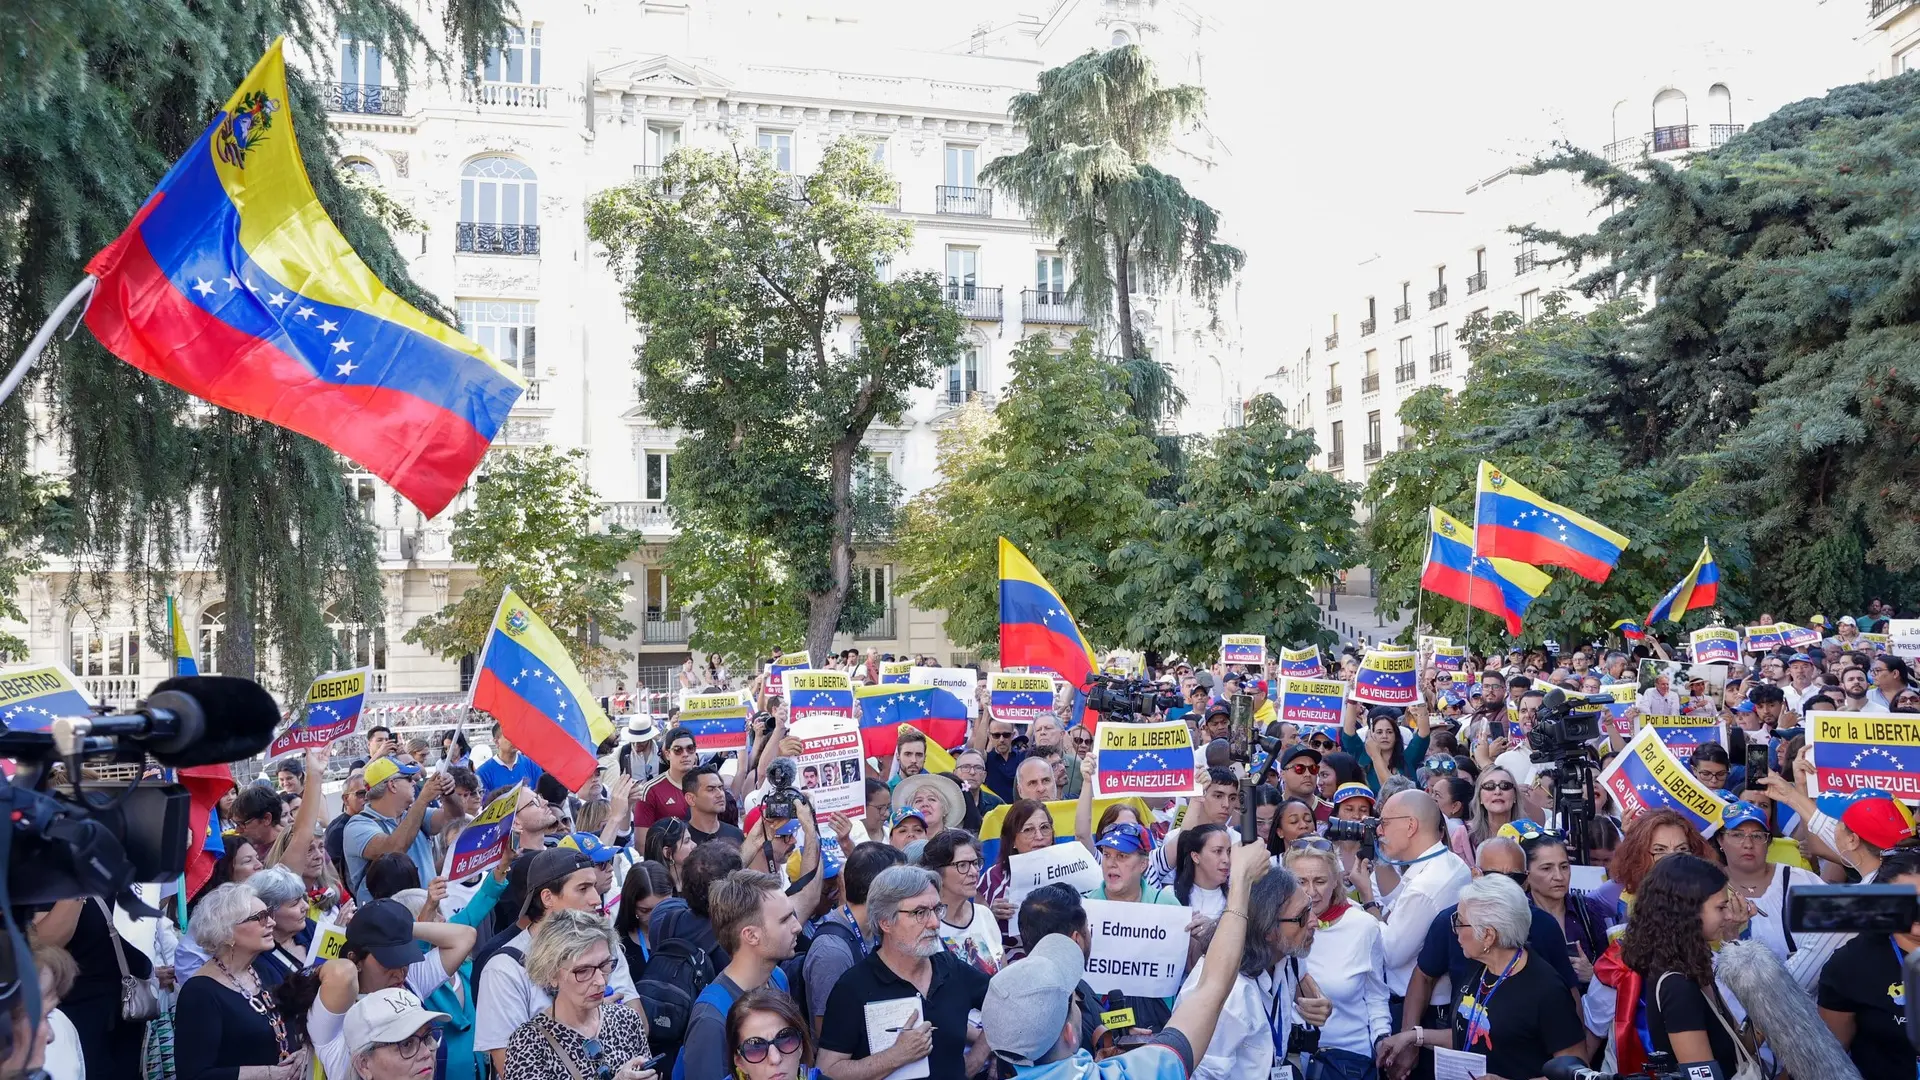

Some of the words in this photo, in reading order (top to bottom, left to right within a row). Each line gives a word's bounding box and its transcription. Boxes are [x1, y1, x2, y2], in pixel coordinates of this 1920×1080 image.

[1374, 659, 1379, 669] la
[1383, 659, 1412, 671] LIBERTAD
[311, 678, 359, 699] LIBERTAD
[794, 676, 806, 687] Por
[809, 677, 815, 687] la
[818, 677, 847, 688] LIBERTAD
[933, 678, 967, 687] Edmundo
[997, 679, 1008, 689] Por
[1011, 680, 1016, 688] la
[1020, 679, 1048, 689] LIBERTAD
[1290, 682, 1299, 691] Por
[1311, 684, 1340, 694] LIBERTAD
[1361, 687, 1369, 695] de
[1370, 689, 1413, 699] VENEZUELA
[688, 700, 699, 709] Por
[701, 700, 706, 709] la
[708, 698, 736, 709] LIBERTAD
[796, 711, 805, 720] de
[1288, 709, 1296, 717] de
[1298, 710, 1336, 720] VENEZUELA
[1646, 715, 1659, 725] Por
[1663, 716, 1669, 724] la
[278, 735, 290, 749] de
[292, 720, 351, 743] VENEZUELA
[1107, 731, 1124, 746] Por
[1129, 733, 1137, 746] la
[1142, 729, 1186, 746] LIBERTAD
[1822, 722, 1841, 739] Por
[1848, 722, 1858, 739] la
[1865, 723, 1920, 741] LIBERTA
[804, 735, 856, 750] REWARD
[797, 750, 846, 762] $15,000,000.00
[1106, 775, 1118, 787] de
[1122, 774, 1186, 787] VENEZUELA
[1641, 743, 1657, 763] Por
[1654, 760, 1665, 775] la
[1663, 771, 1716, 815] LIBERTAD
[1828, 773, 1843, 786] de
[1845, 774, 1920, 793] VENEZUEL
[1615, 779, 1626, 793] de
[456, 858, 467, 873] de
[1047, 858, 1089, 880] Edmundo
[1102, 921, 1167, 940] Edmundo
[1084, 958, 1159, 978] ESIDENTE
[1166, 963, 1175, 978] !!
[383, 991, 418, 1014] M
[1111, 1015, 1127, 1024] data
